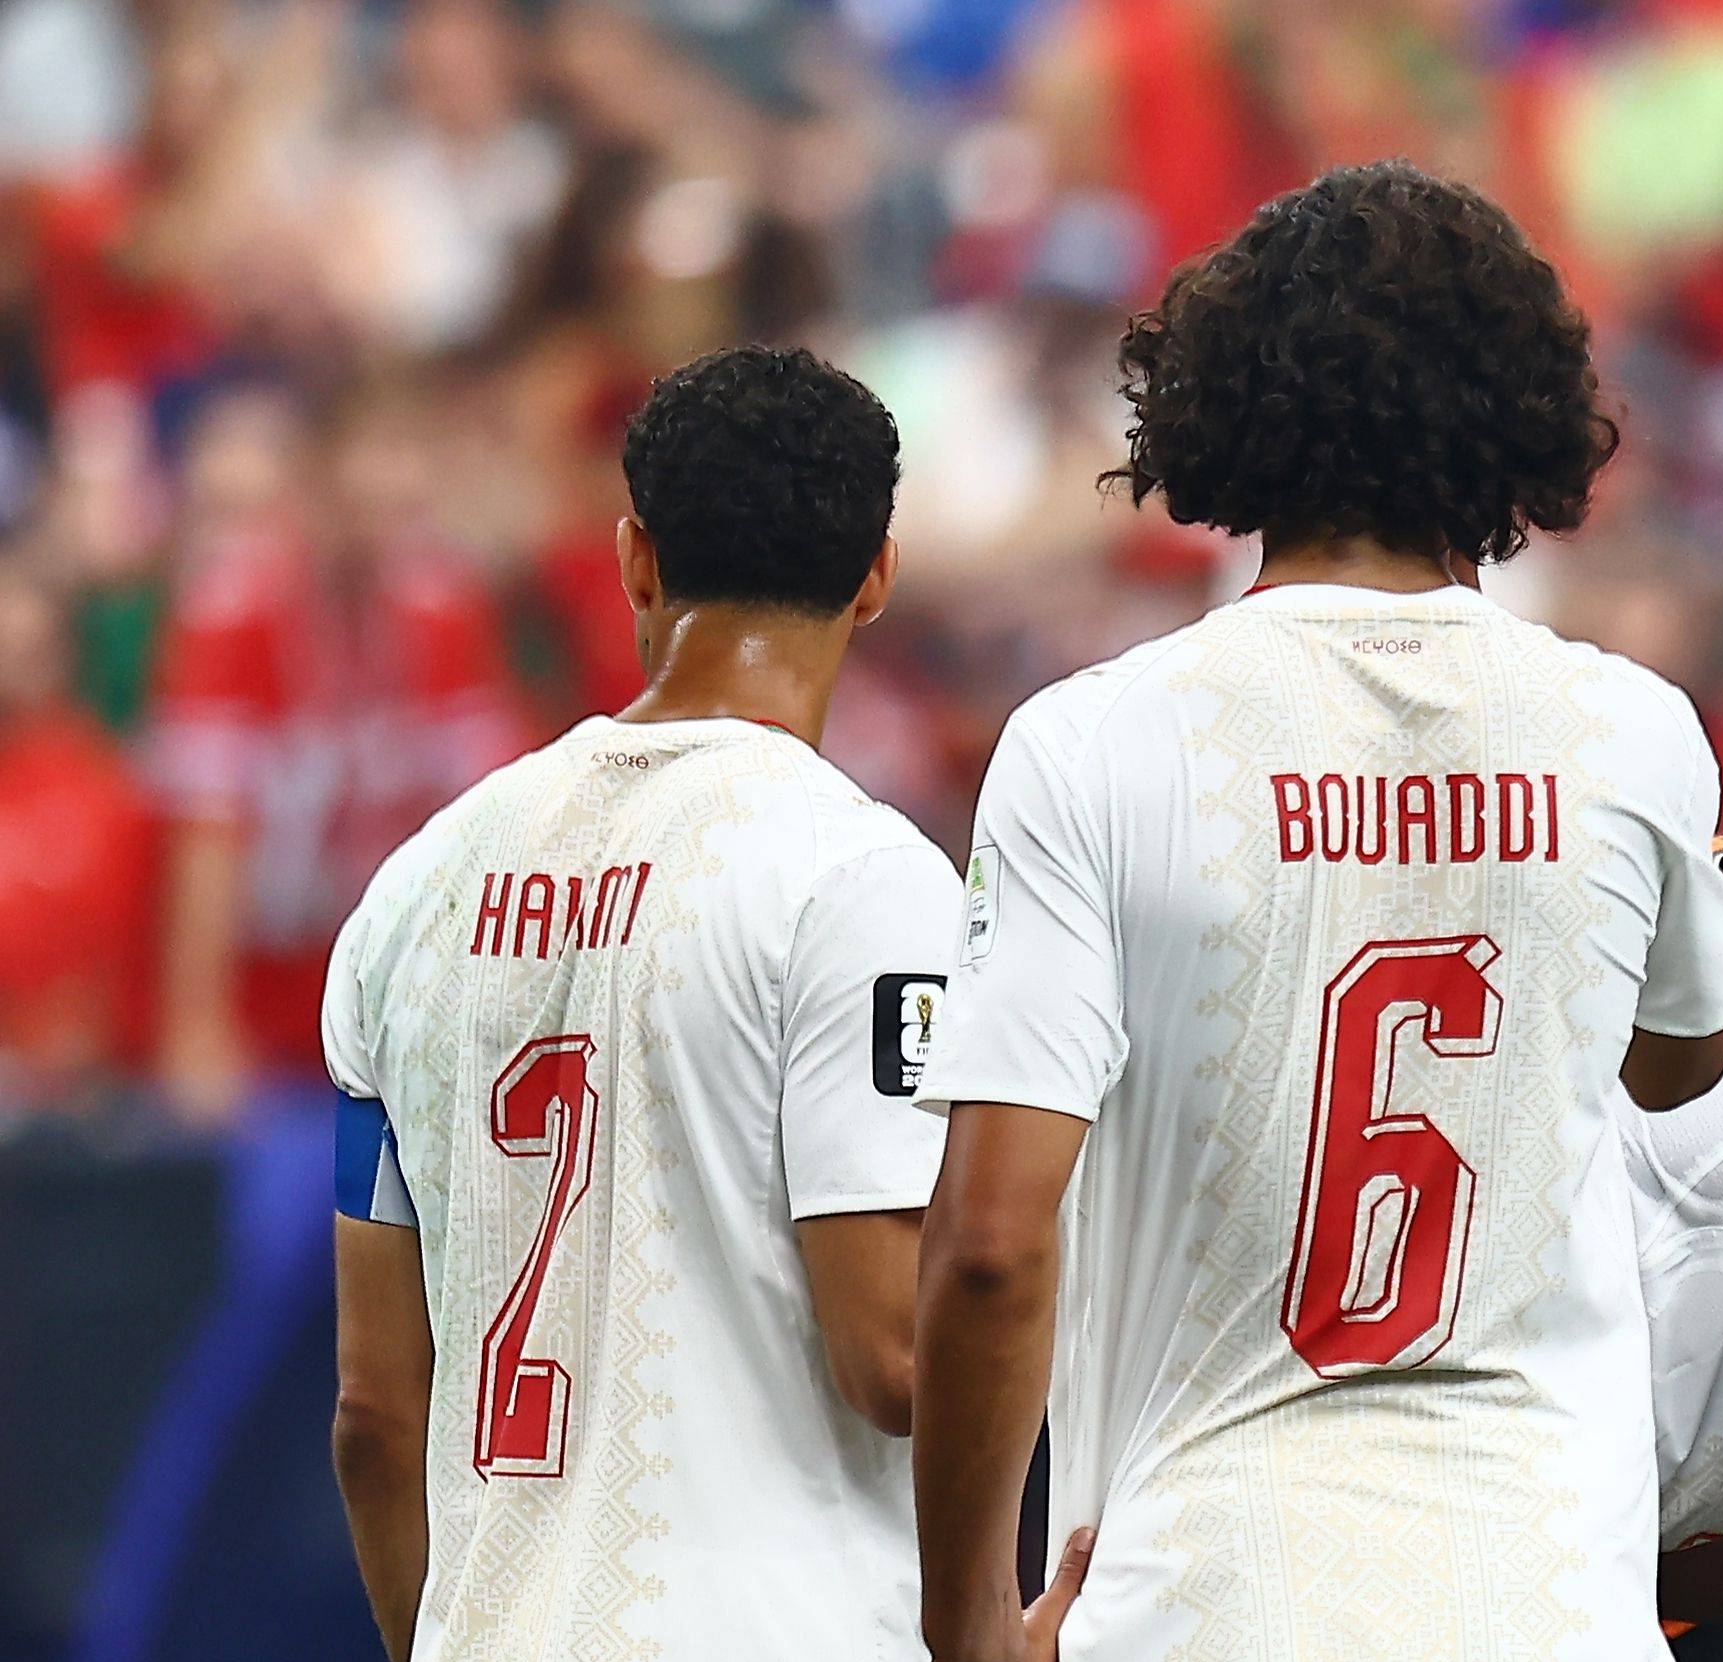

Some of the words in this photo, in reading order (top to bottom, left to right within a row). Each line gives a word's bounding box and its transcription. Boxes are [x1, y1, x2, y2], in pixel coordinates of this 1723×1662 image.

[1270, 773, 1559, 865] BOUADDI
[473, 1033, 599, 1482] 2
[1280, 933, 1504, 1380] 6
